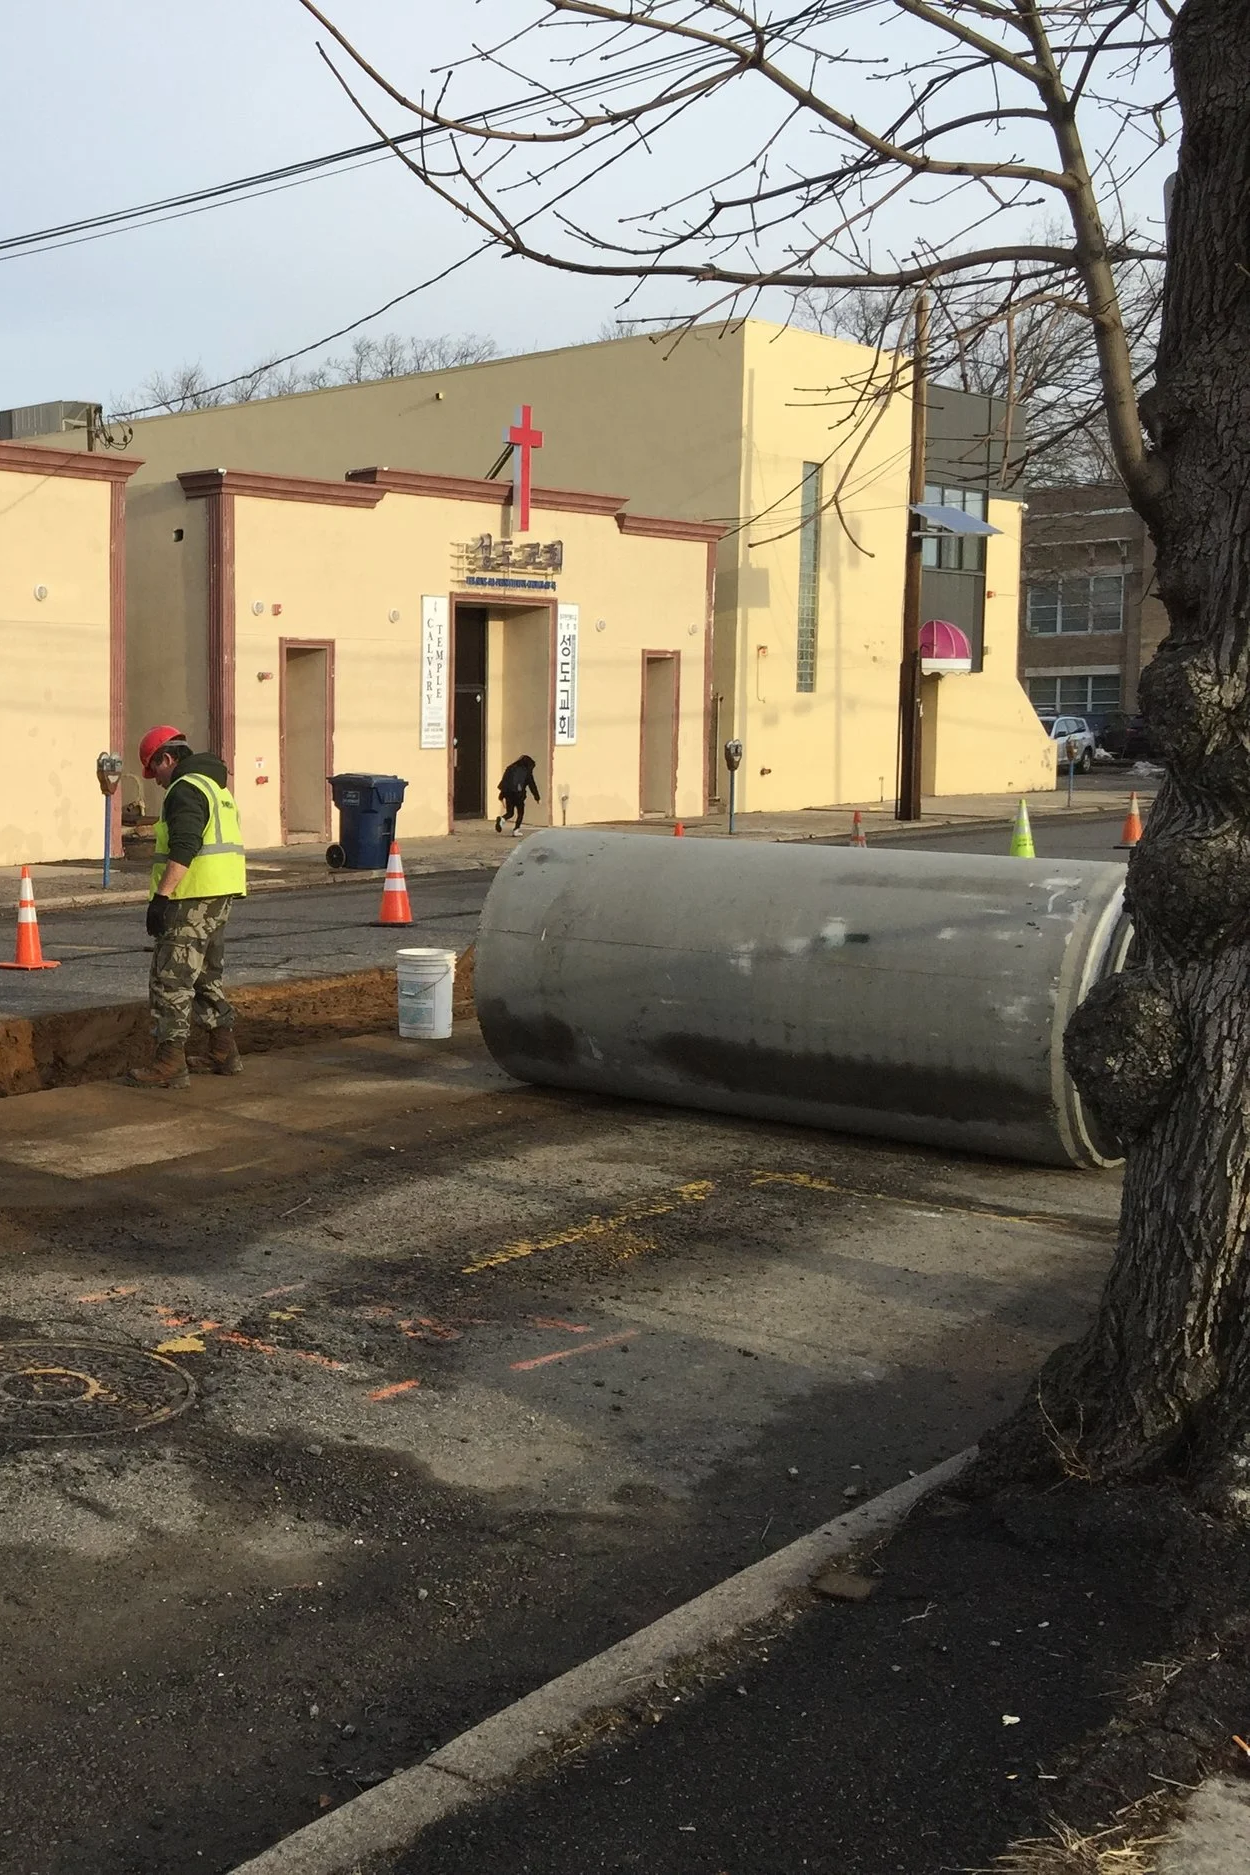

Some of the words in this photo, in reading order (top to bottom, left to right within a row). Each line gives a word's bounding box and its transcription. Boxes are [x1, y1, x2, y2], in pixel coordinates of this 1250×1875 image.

[426, 617, 434, 705] CALVARY
[436, 624, 444, 699] TEMPLE
[558, 634, 571, 739] 성도교회
